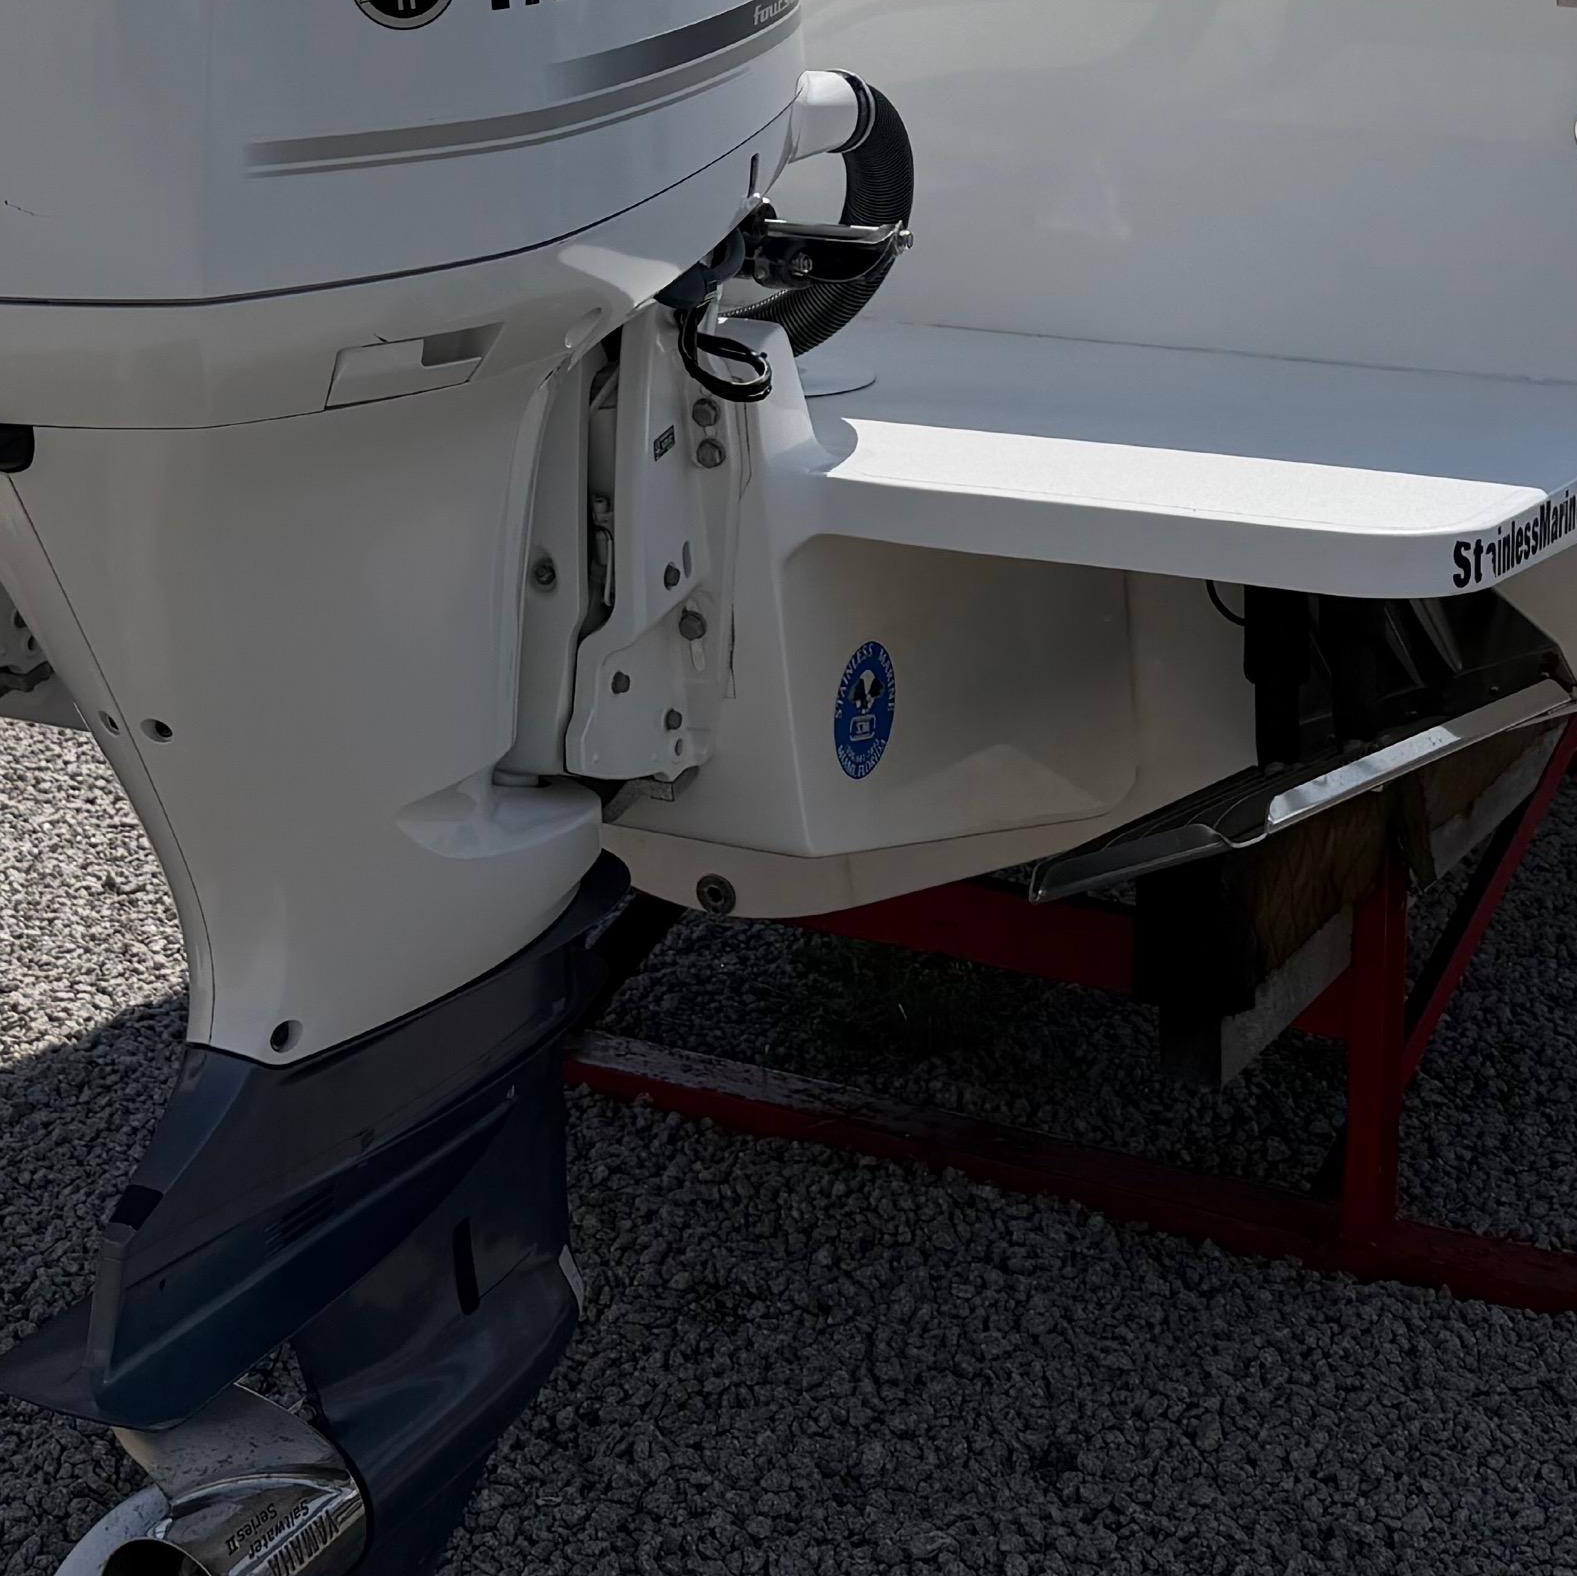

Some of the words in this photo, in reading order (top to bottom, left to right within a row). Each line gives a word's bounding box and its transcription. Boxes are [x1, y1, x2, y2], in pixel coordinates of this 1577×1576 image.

[835, 642, 874, 719] STAINLESS
[878, 647, 896, 712] MARINE
[236, 1502, 279, 1542] Series
[248, 1498, 310, 1560] Saltwater
[266, 1509, 340, 1576] YAMAHA
